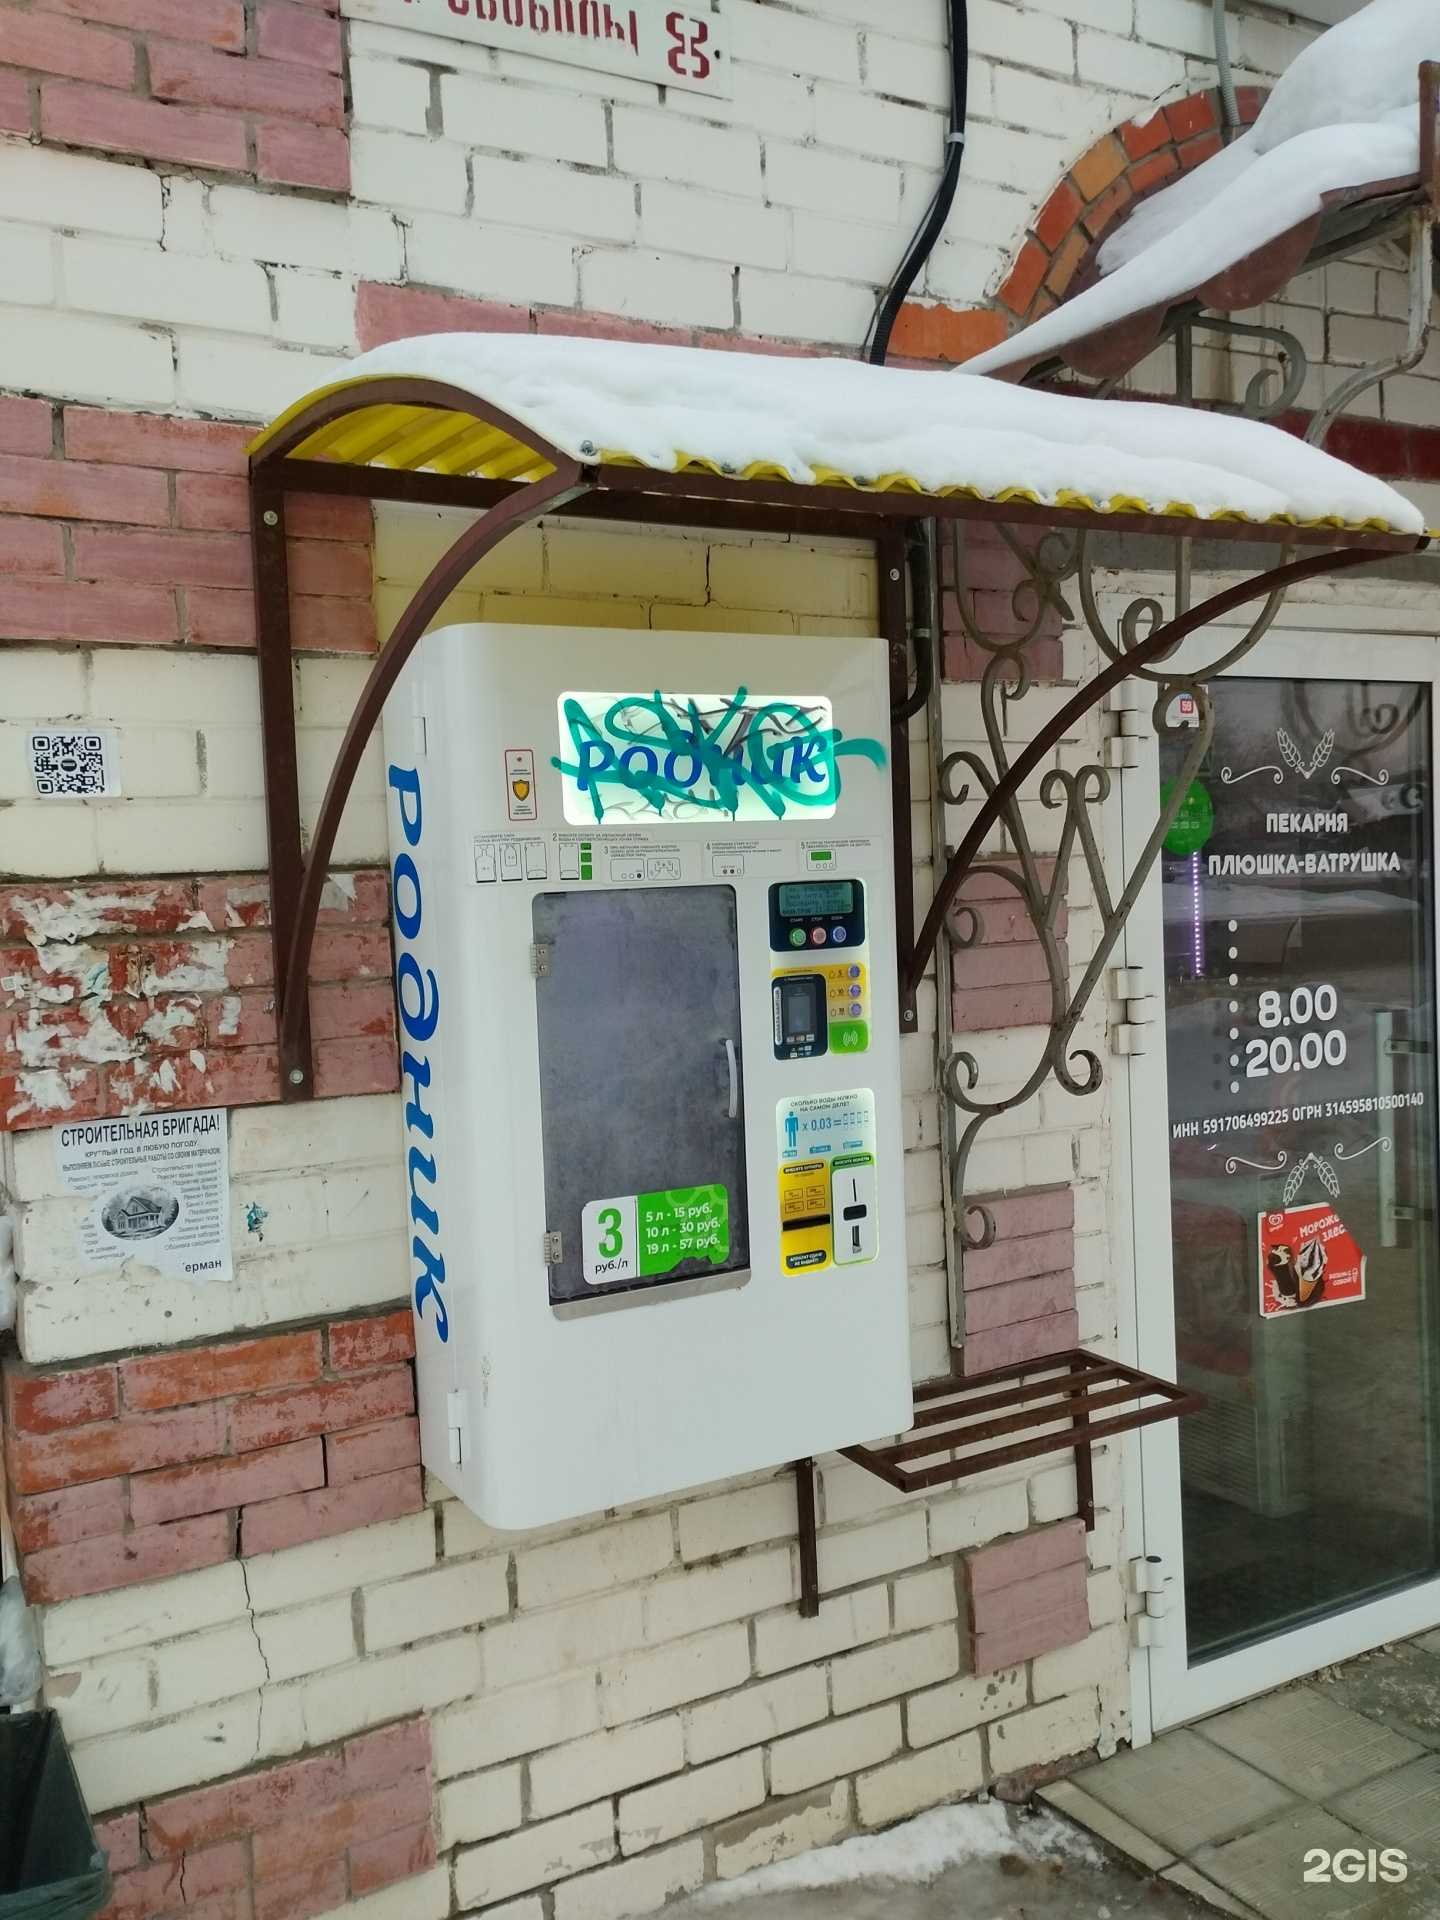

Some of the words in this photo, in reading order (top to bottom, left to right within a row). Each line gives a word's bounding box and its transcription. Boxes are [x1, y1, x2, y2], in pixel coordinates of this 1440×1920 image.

[1266, 812, 1349, 833] ПЕКАРНЯ
[1208, 851, 1401, 876] ПЛЮШКА-ВАТРУШКА
[1258, 984, 1338, 1029] 8.00
[1245, 1029, 1347, 1078] 20.00
[1172, 1120, 1199, 1139] ИНН
[1202, 1108, 1290, 1135] 591706499225
[1292, 1104, 1323, 1122] ОГРН
[1325, 1092, 1425, 1117] 314595810500140
[60, 1120, 159, 1148] СТРОИТЕЛЬНАЯ
[162, 1113, 220, 1137] БРИГАДА!
[645, 1211, 653, 1223] 5
[655, 1212, 664, 1221] л
[673, 1206, 686, 1218] 15
[688, 1202, 713, 1218] руб.
[597, 1207, 624, 1259] 3
[645, 1226, 659, 1238] 10
[661, 1227, 670, 1237] л
[679, 1221, 694, 1234] 30
[696, 1217, 721, 1233] руб.
[645, 1243, 659, 1255] 19
[661, 1243, 670, 1253] л
[679, 1238, 693, 1250] 57
[696, 1233, 721, 1249] руб.
[594, 1258, 628, 1275] руб./л
